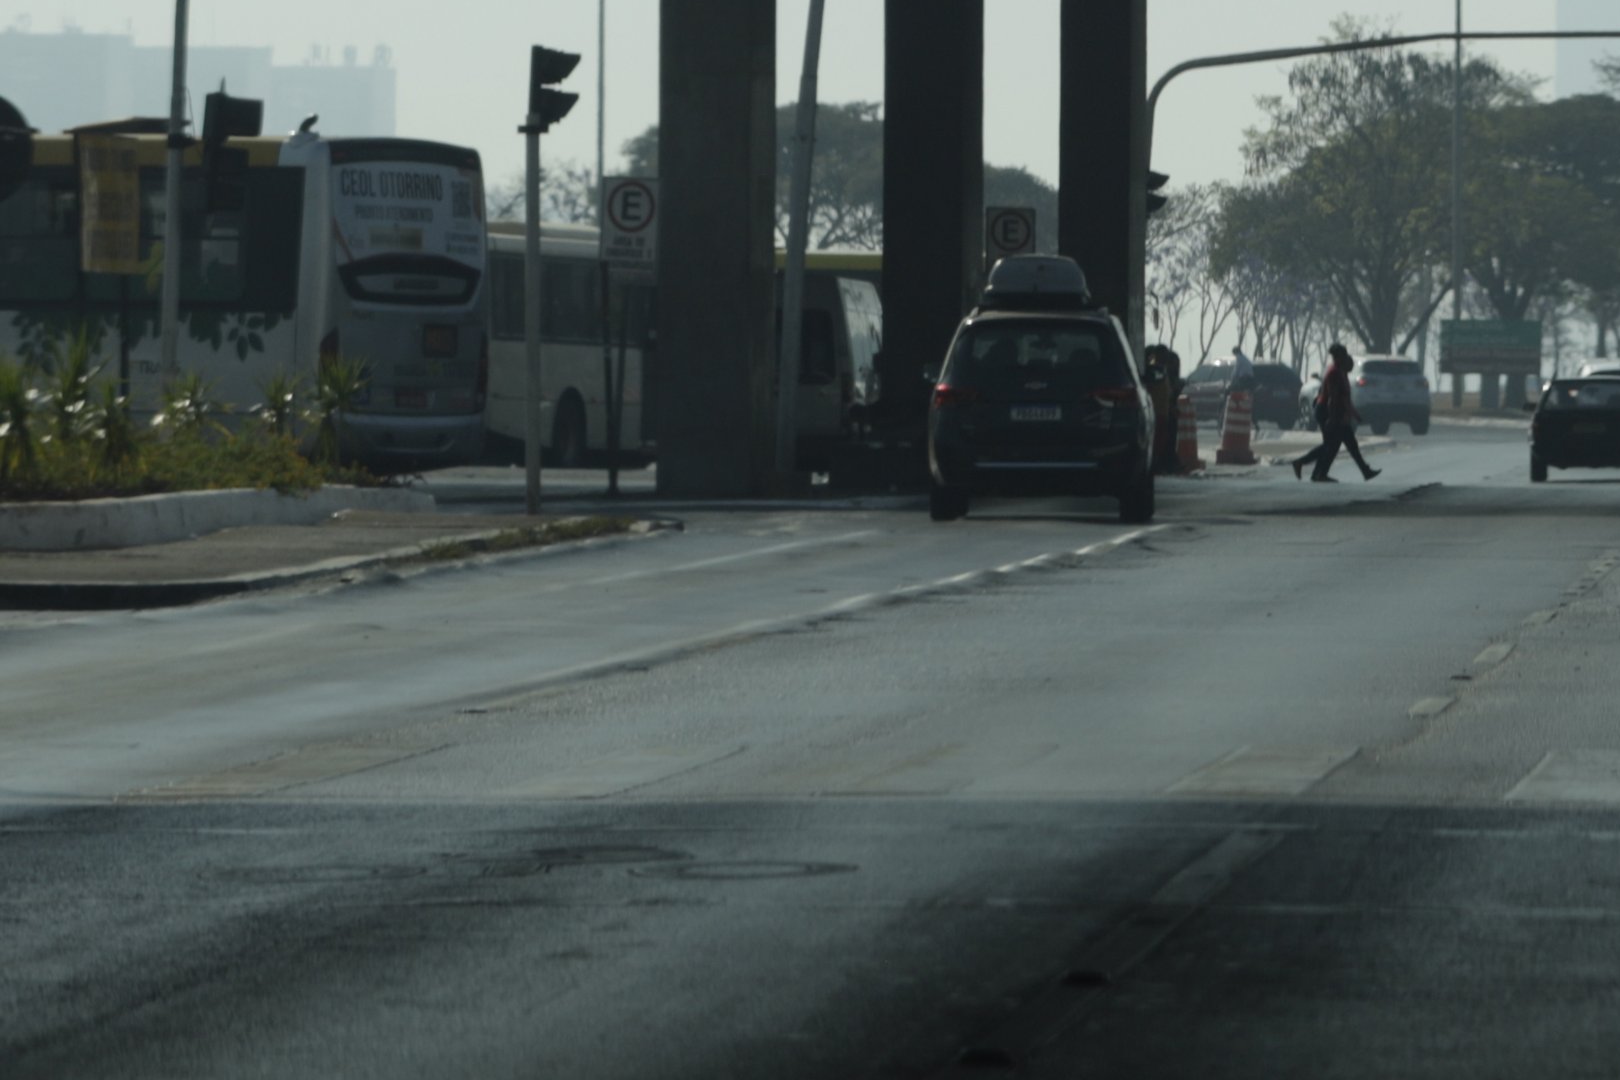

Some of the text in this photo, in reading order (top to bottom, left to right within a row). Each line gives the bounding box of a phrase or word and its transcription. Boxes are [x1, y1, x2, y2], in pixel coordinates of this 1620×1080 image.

[340, 169, 444, 201] CEOL OTORRINO
[622, 190, 641, 220] E
[1003, 219, 1019, 243] E
